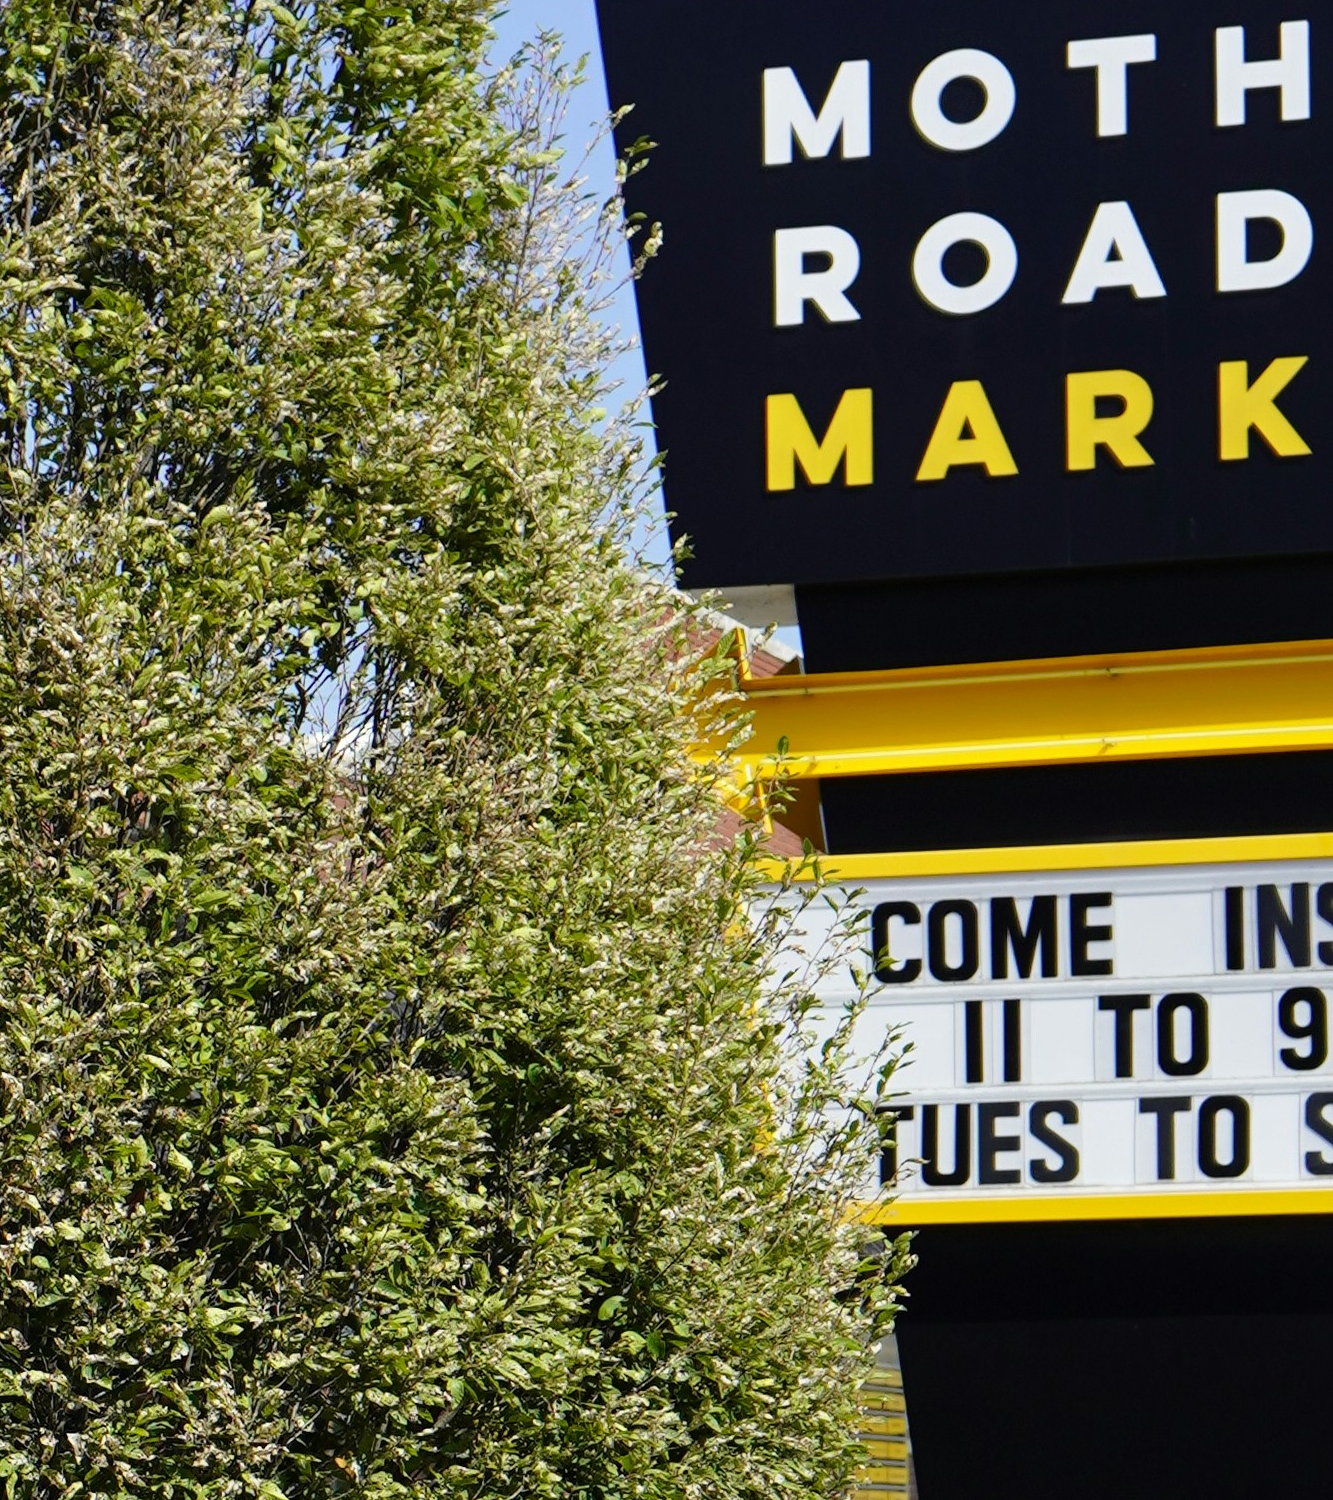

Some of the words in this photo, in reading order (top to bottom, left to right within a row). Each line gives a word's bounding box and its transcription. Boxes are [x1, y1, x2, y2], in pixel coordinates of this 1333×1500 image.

[763, 20, 1311, 167] MOTH
[773, 190, 1313, 327] ROAD
[765, 356, 1313, 492] MARK
[871, 892, 1113, 984] COME
[1098, 993, 1209, 1078] TO
[1278, 986, 1328, 1071] 9
[874, 1100, 1080, 1188] TUES
[1139, 1095, 1250, 1180] TO
